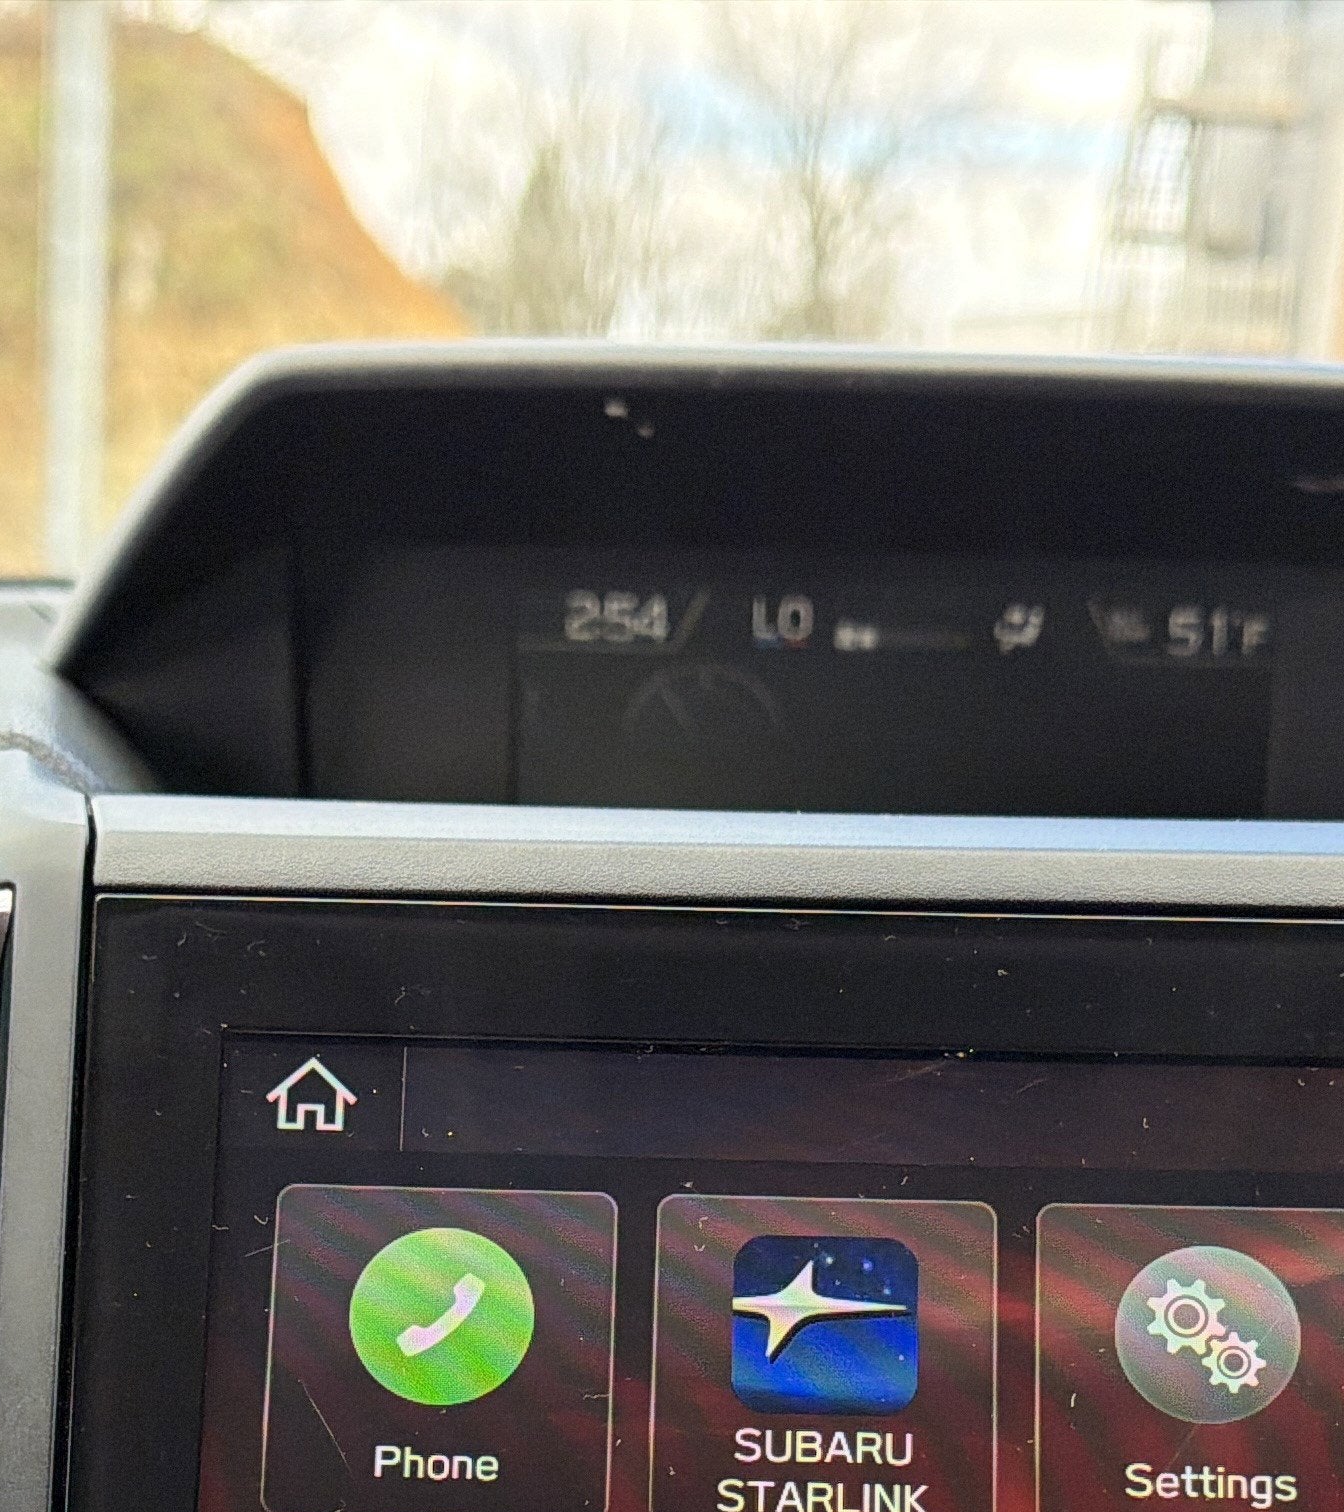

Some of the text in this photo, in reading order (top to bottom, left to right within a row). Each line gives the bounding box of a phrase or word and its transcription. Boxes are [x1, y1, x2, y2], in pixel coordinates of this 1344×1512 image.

[752, 594, 814, 640] LO
[373, 1444, 500, 1482] Phone
[734, 1427, 914, 1468] SUBARU
[1124, 1462, 1298, 1511] Settings
